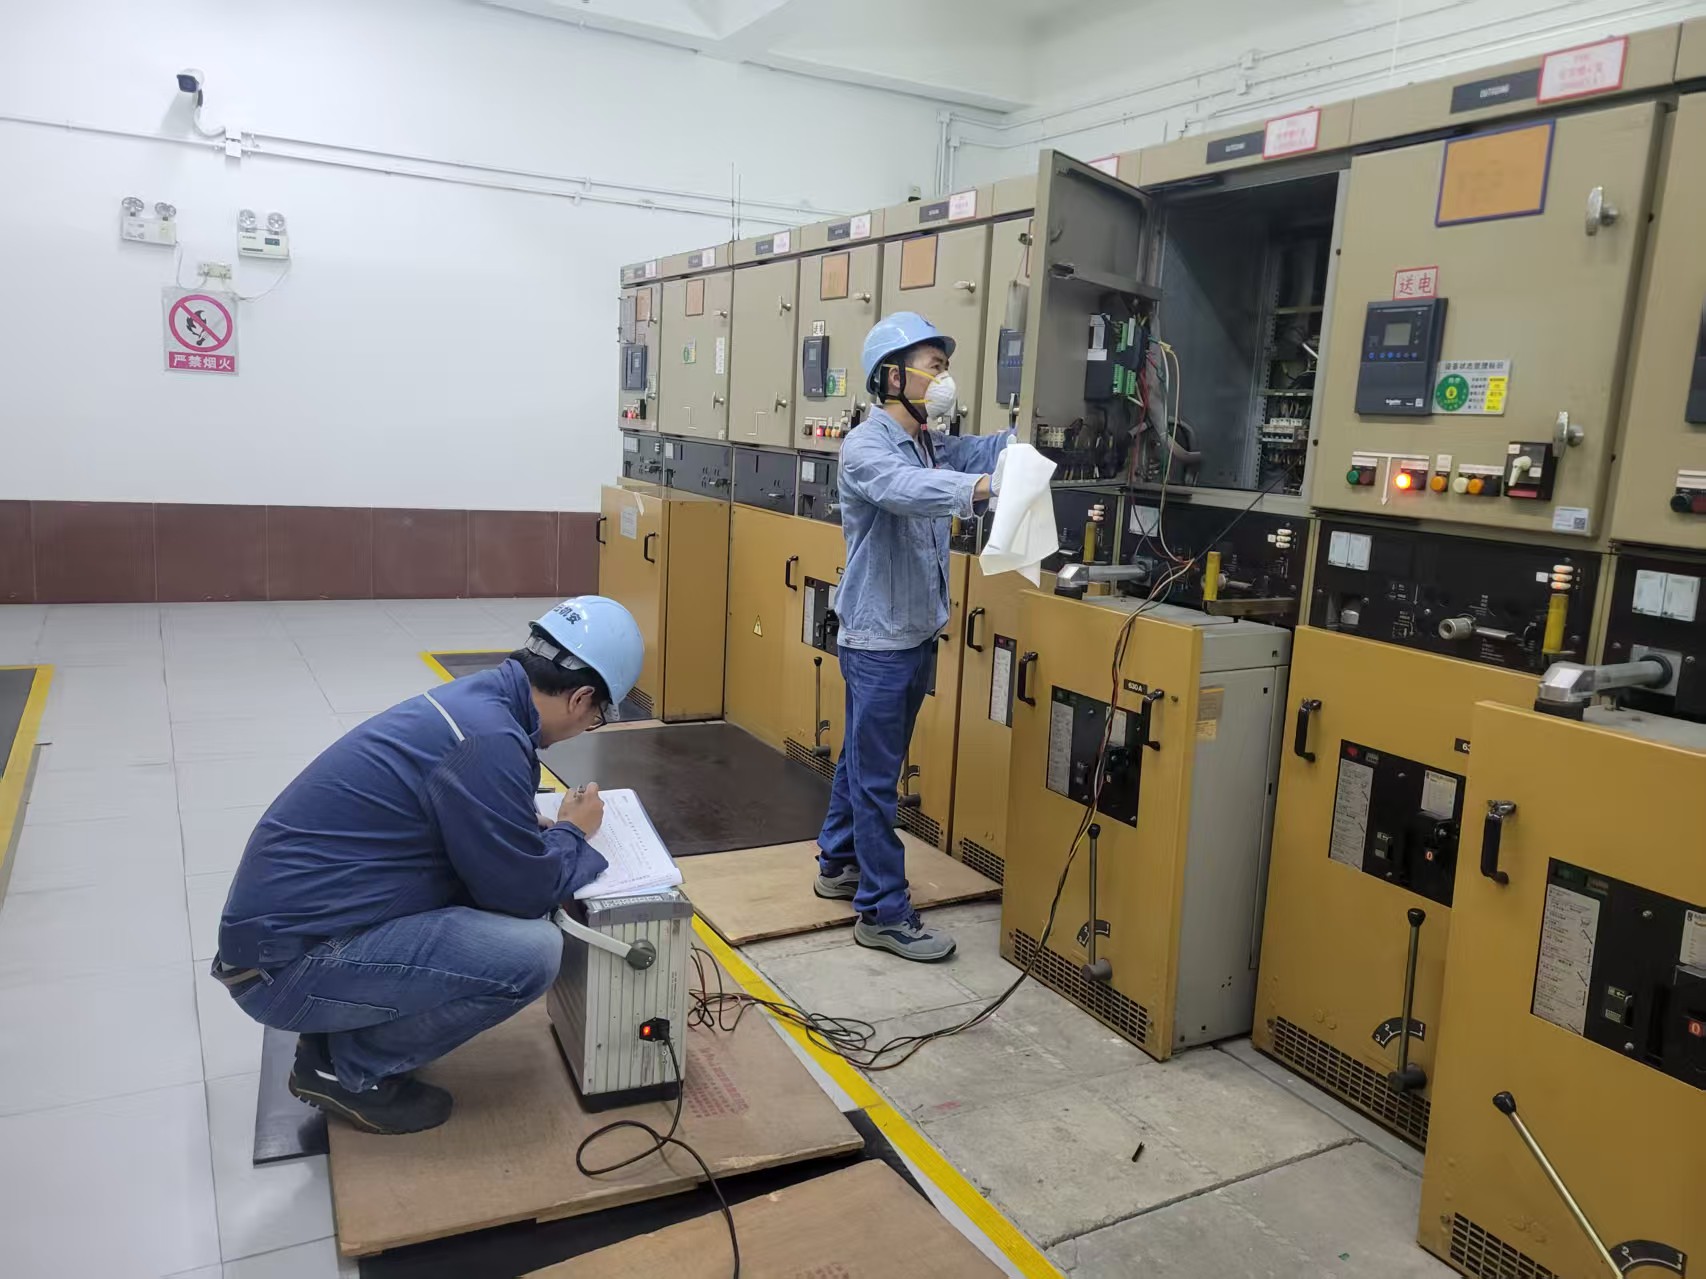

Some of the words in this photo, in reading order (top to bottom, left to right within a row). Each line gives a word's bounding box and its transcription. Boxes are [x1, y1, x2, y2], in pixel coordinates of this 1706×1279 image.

[1399, 272, 1432, 295] 送电
[173, 354, 232, 370] 严禁烟火
[1375, 1034, 1380, 1042] 3
[1384, 1023, 1390, 1031] 2
[1621, 1246, 1630, 1257] 2
[1676, 1252, 1684, 1263] 1
